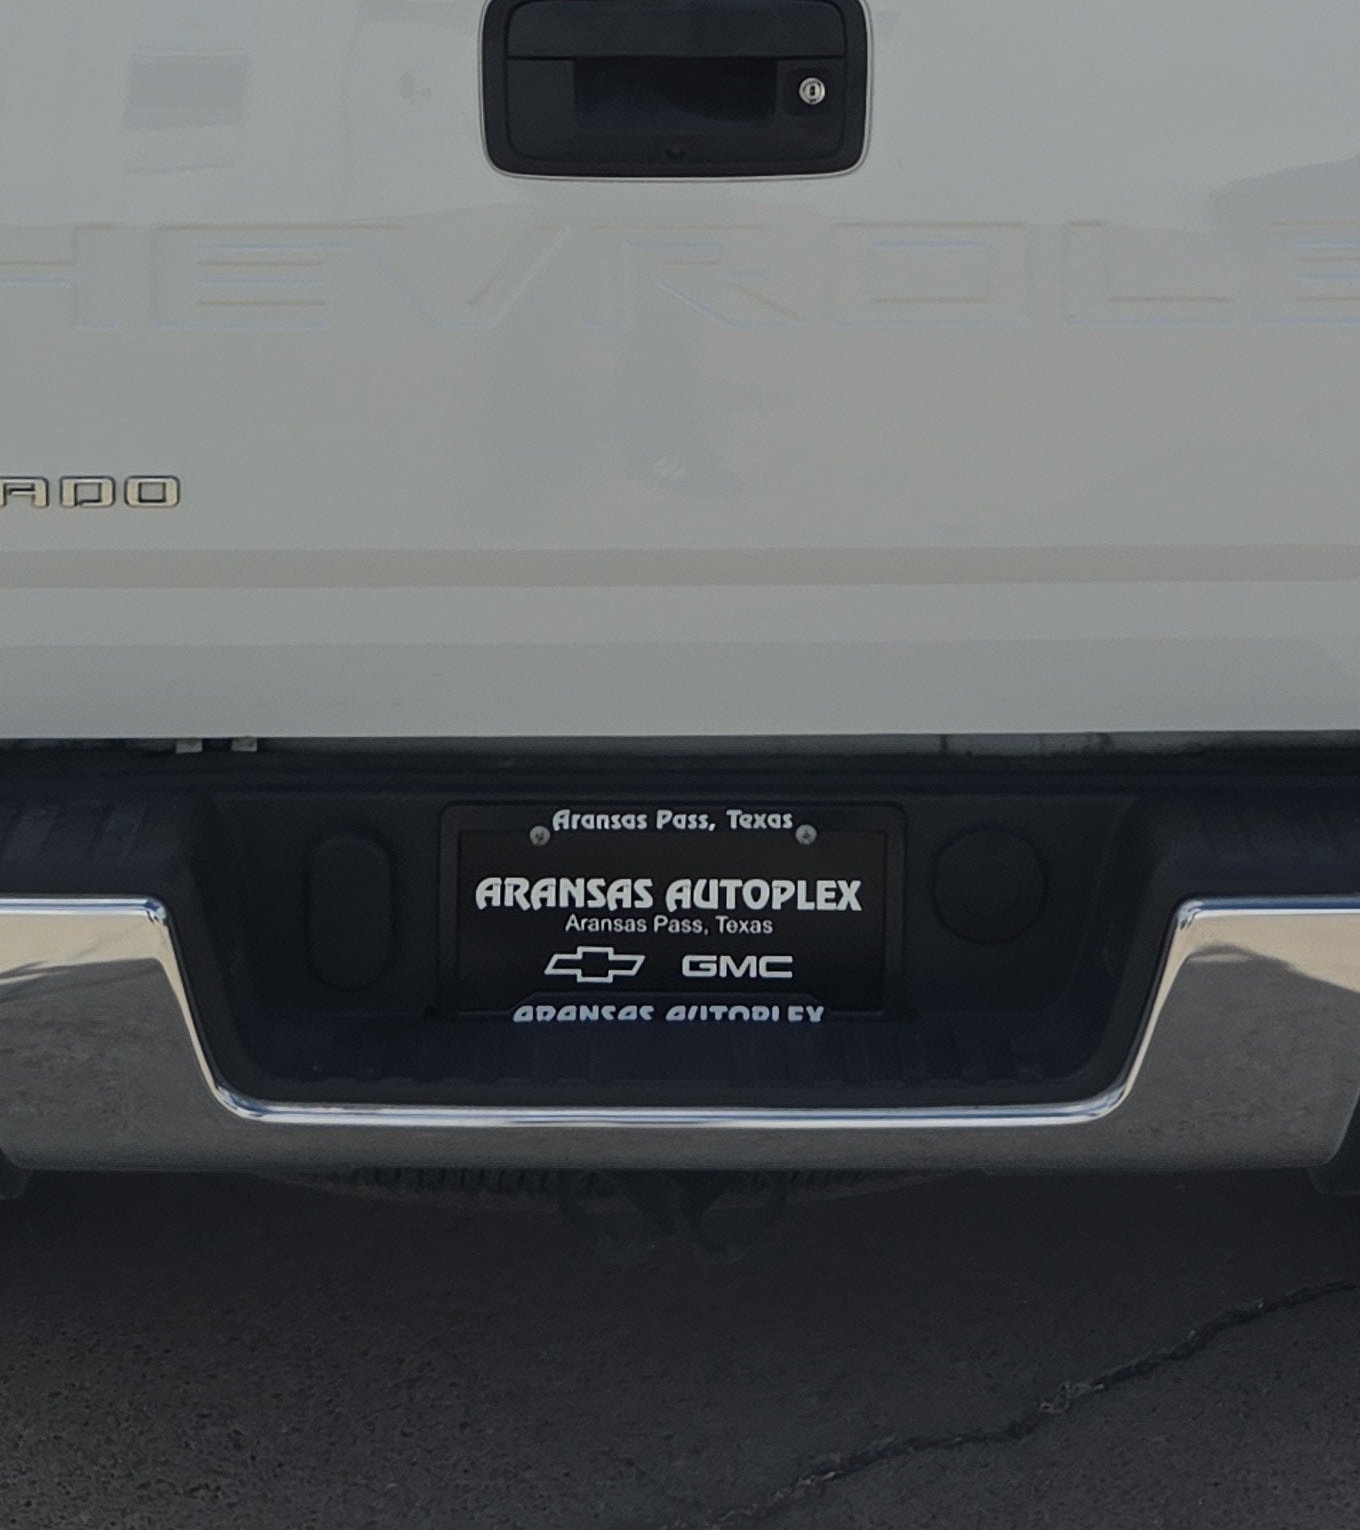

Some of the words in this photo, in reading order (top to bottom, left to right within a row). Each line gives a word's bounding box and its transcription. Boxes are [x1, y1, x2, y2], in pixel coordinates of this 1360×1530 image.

[552, 809, 648, 831] Aransas
[656, 810, 716, 831] Pass,
[726, 810, 793, 830] Texas
[475, 877, 654, 912] ARANSAS
[665, 878, 862, 912] AUTOPLEX
[565, 914, 647, 933] Aransas
[653, 915, 708, 935] Pass,
[715, 916, 773, 934] Texas
[682, 954, 793, 978] GMC
